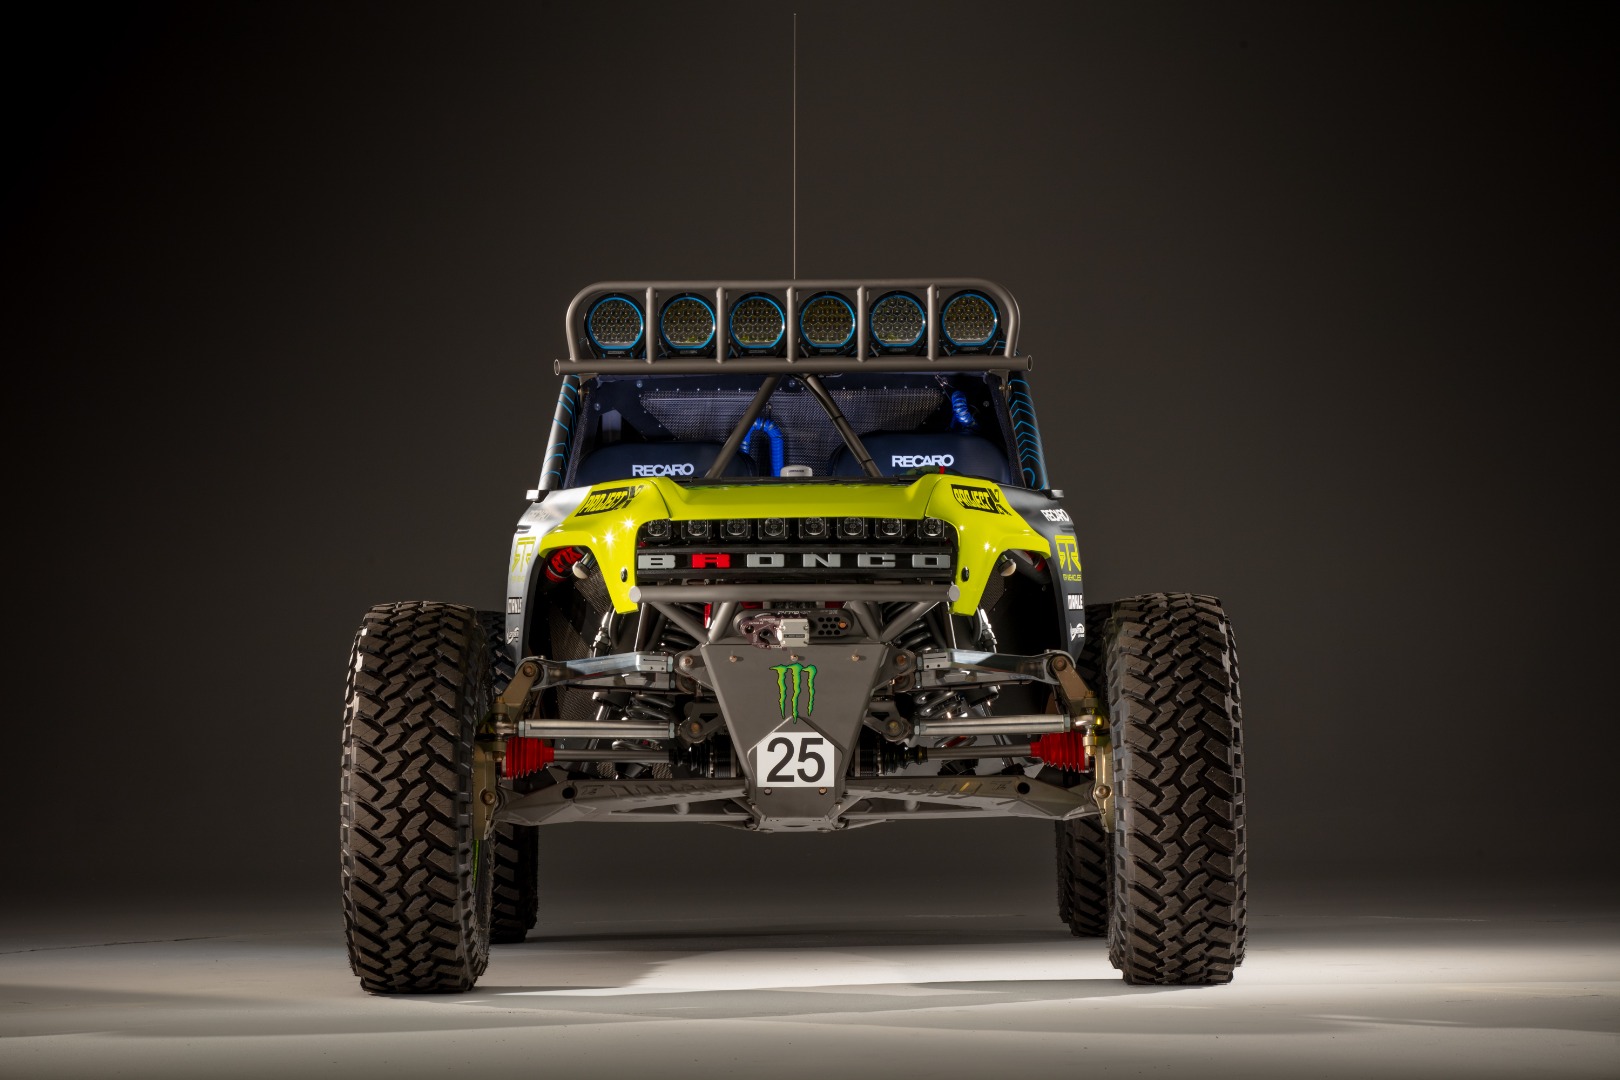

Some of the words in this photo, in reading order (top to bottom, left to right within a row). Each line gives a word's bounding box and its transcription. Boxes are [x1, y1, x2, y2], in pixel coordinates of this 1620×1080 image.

[632, 463, 694, 477] RECARO
[892, 454, 954, 468] RECARO
[577, 489, 629, 514] PROJECT
[952, 487, 995, 511] PROJECT
[637, 553, 951, 570] BRONCO
[766, 737, 825, 783] 25
